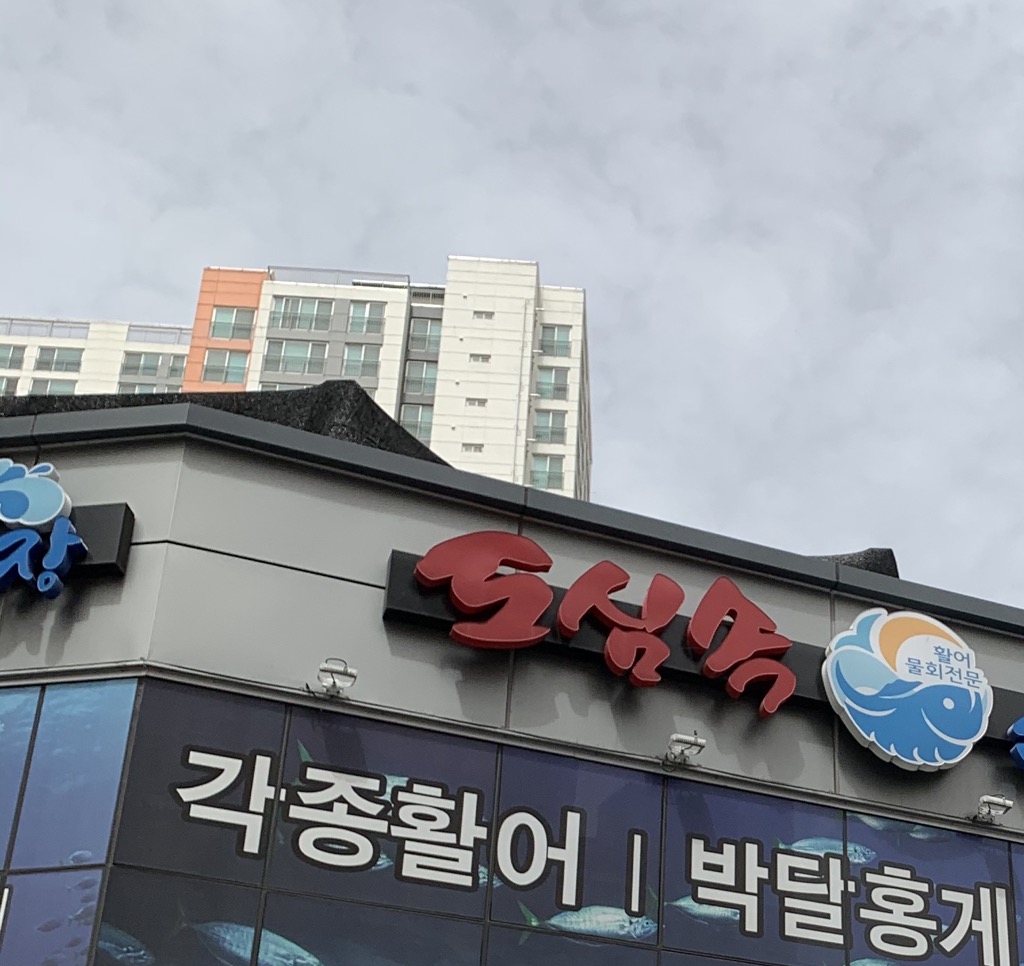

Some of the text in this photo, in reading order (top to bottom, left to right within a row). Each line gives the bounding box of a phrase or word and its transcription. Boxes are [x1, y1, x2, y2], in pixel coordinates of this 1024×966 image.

[413, 529, 798, 719] 도심속
[933, 645, 971, 669] 활어
[905, 657, 983, 689] 물회전문
[176, 748, 582, 909] 각종활어
